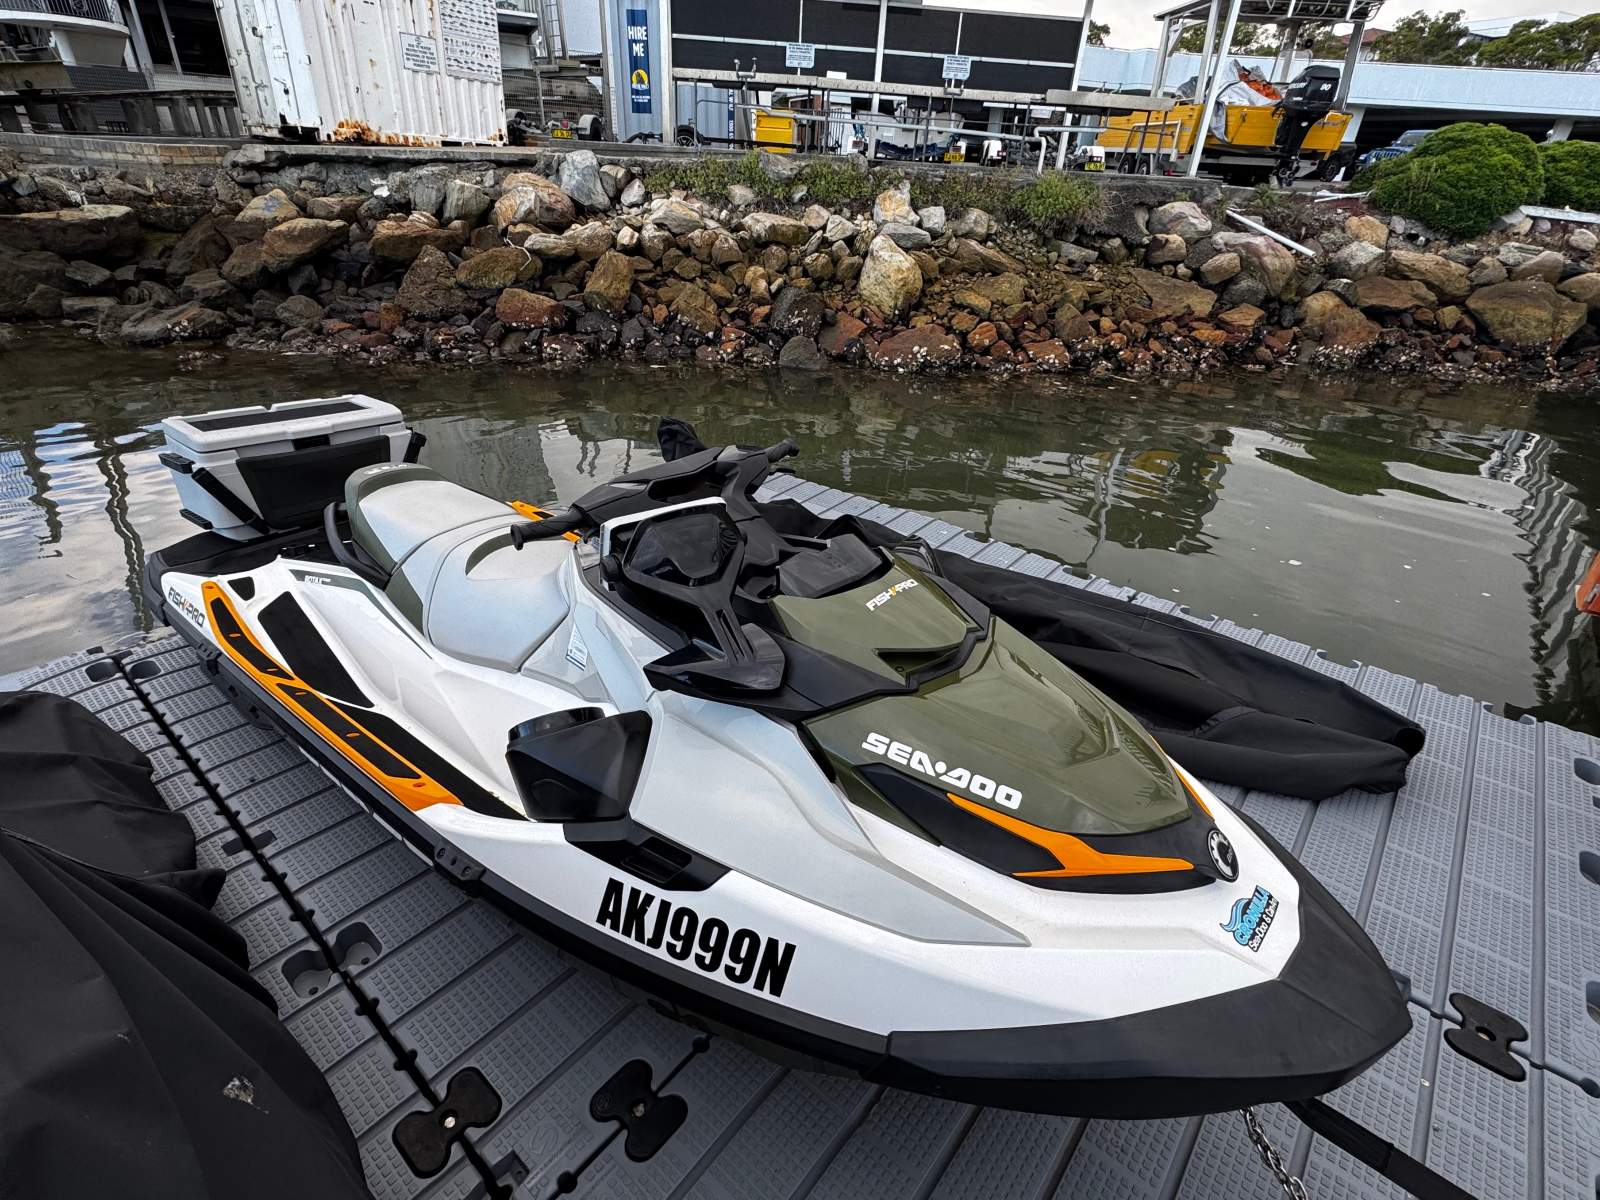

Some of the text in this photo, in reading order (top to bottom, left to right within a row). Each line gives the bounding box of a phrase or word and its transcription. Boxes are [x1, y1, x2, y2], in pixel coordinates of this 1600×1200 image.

[628, 26, 648, 40] HIRE
[632, 43, 645, 57] ME
[1234, 885, 1270, 946] CRONULLA
[596, 877, 797, 998] AKJ999N
